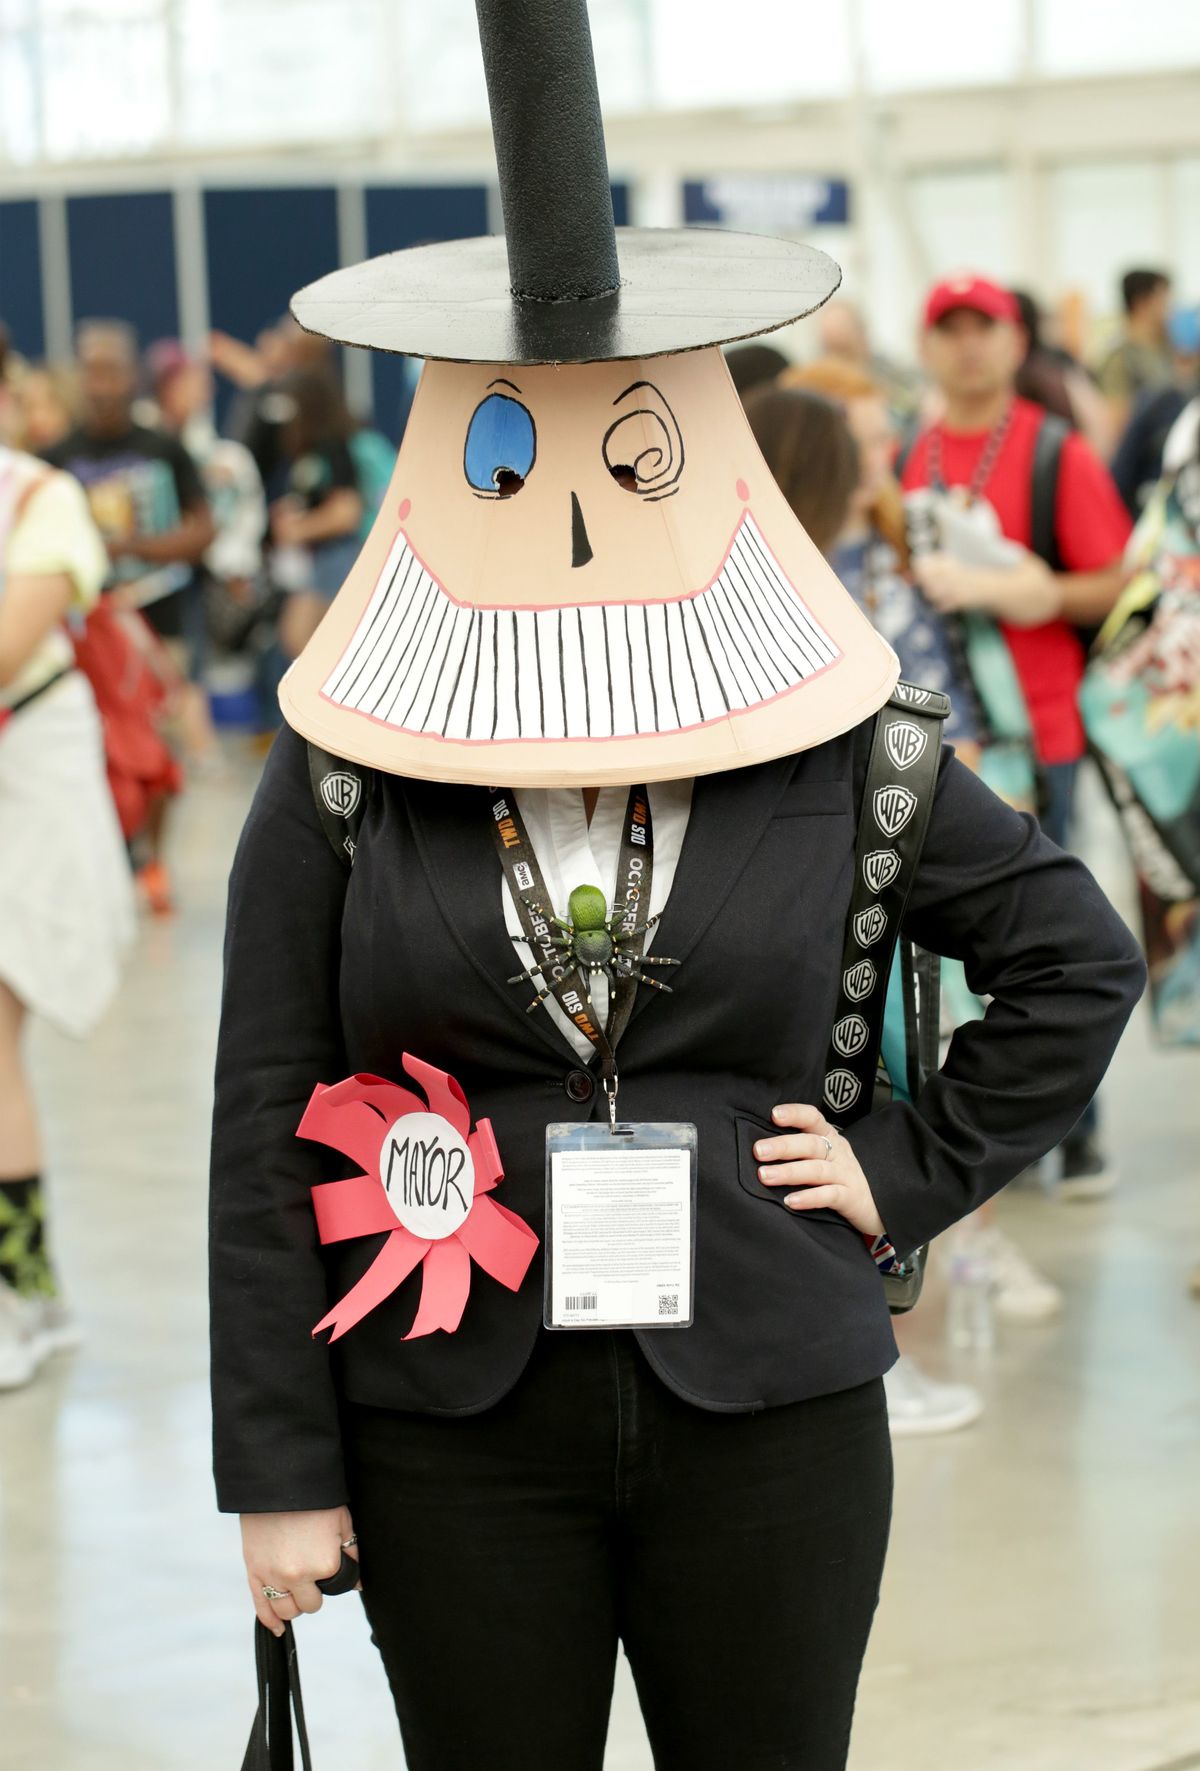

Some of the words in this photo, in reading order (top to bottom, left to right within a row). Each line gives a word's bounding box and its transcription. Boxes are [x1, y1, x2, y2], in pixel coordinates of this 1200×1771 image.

[889, 725, 922, 766] WB
[324, 777, 356, 813] WB
[492, 799, 510, 821] S10
[878, 791, 911, 832] WB
[497, 818, 520, 849] TWD
[630, 823, 646, 846] S10
[868, 854, 896, 889] WB
[858, 908, 884, 943] WB
[848, 962, 873, 998] WB
[561, 990, 584, 1014] S10
[575, 1013, 600, 1041] TWD
[835, 1018, 865, 1053] WB
[825, 1073, 856, 1109] WB
[386, 1135, 468, 1212] MAYOR
